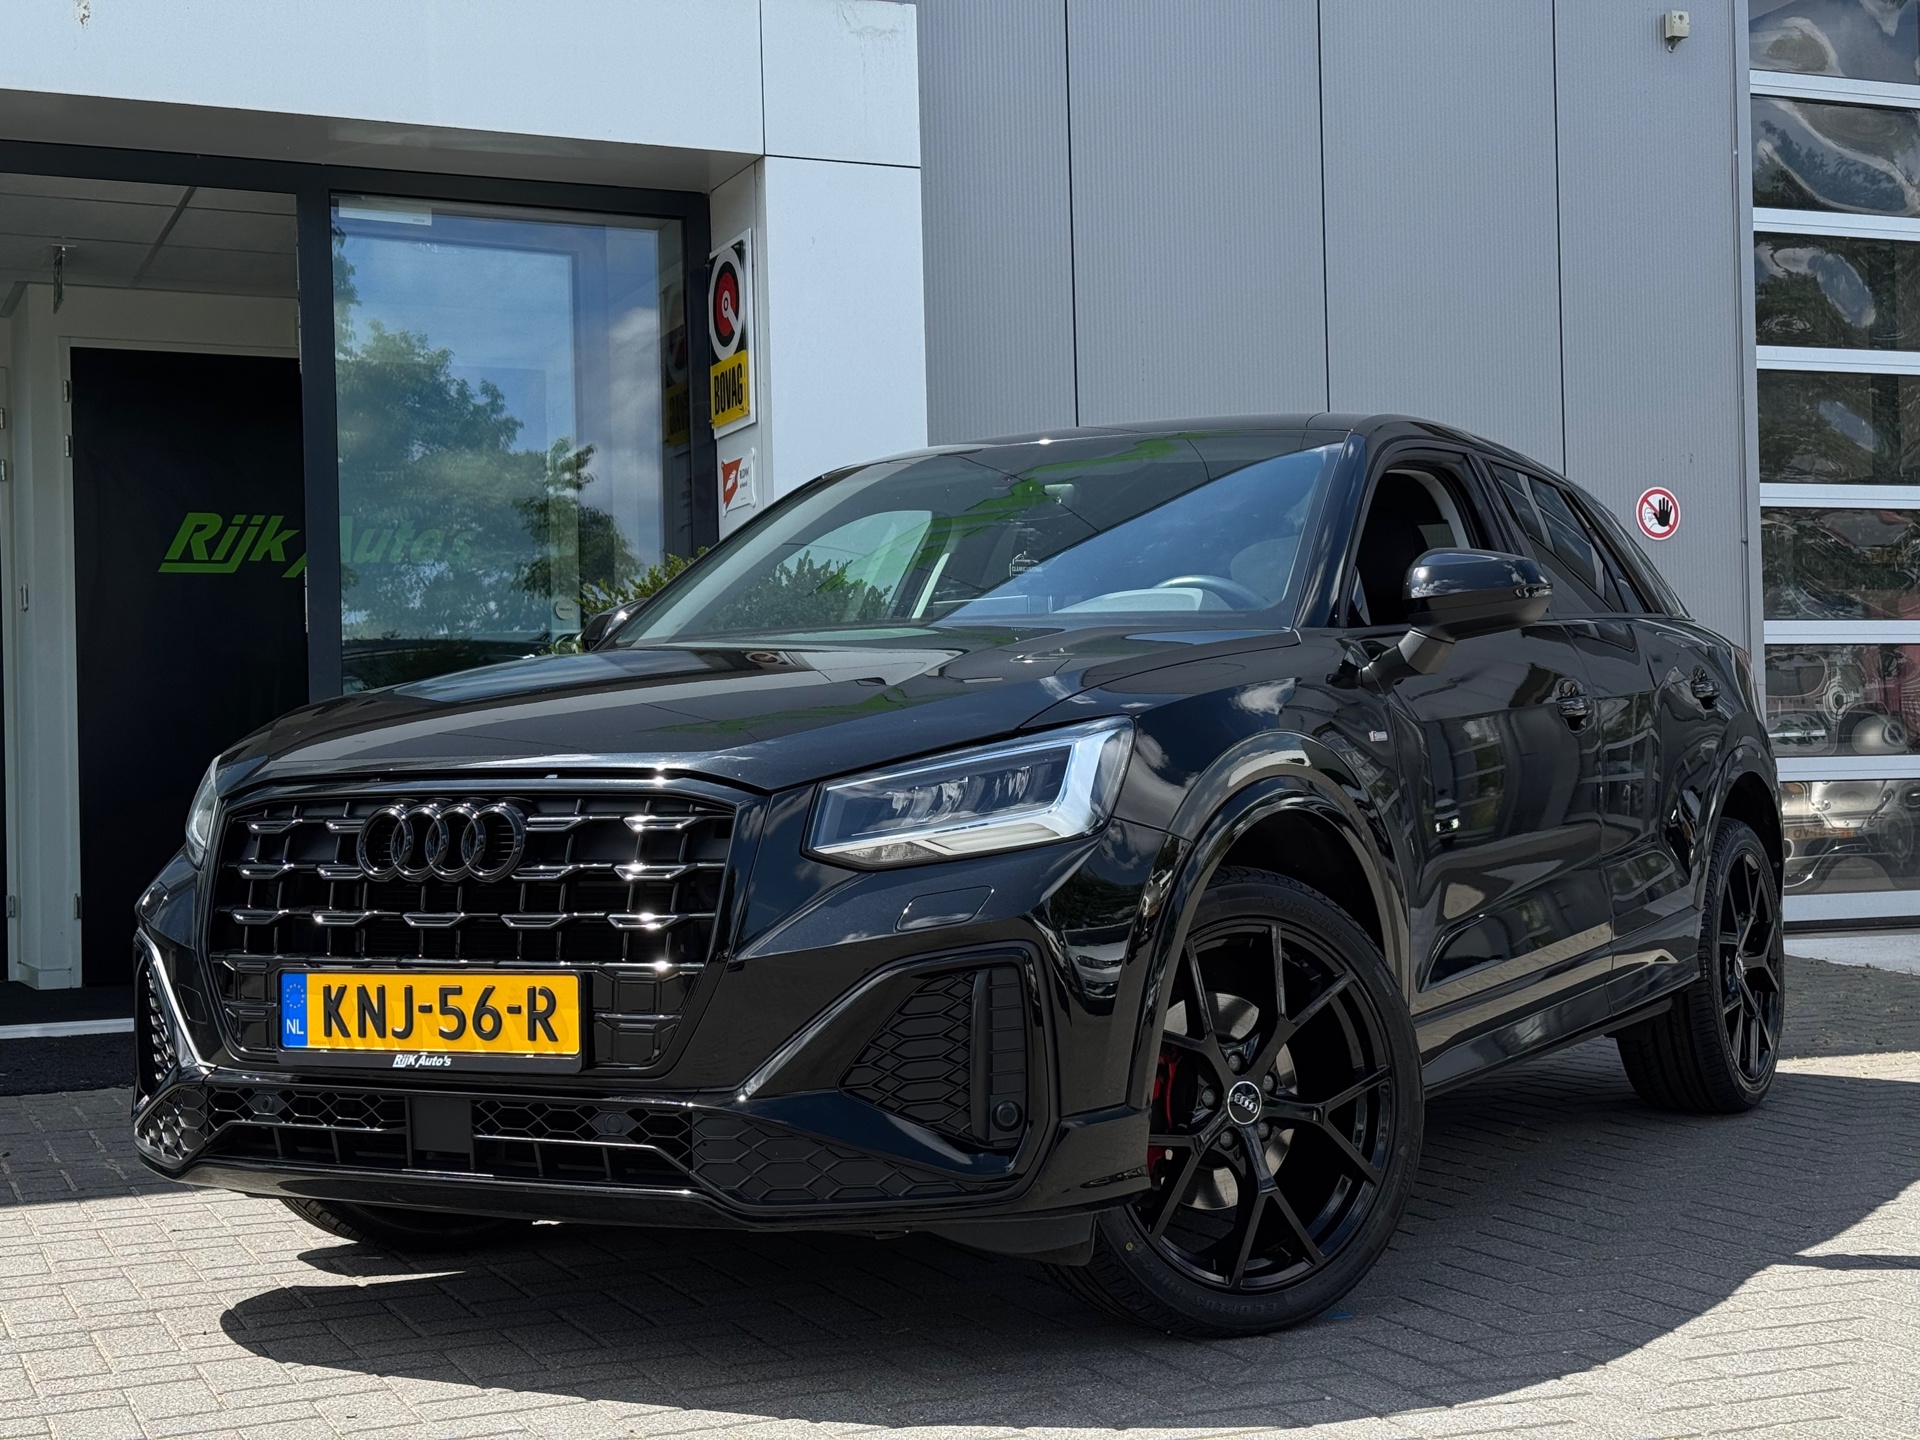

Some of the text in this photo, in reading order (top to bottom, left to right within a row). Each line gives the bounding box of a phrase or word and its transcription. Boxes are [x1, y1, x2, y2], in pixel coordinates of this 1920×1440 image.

[714, 363, 743, 416] BOVAG
[158, 512, 300, 573] Rijk
[1260, 897, 1346, 940] FORTUNA
[286, 1019, 304, 1035] NL
[322, 984, 559, 1042] KNJ-56-R
[415, 1055, 452, 1068] Auto's
